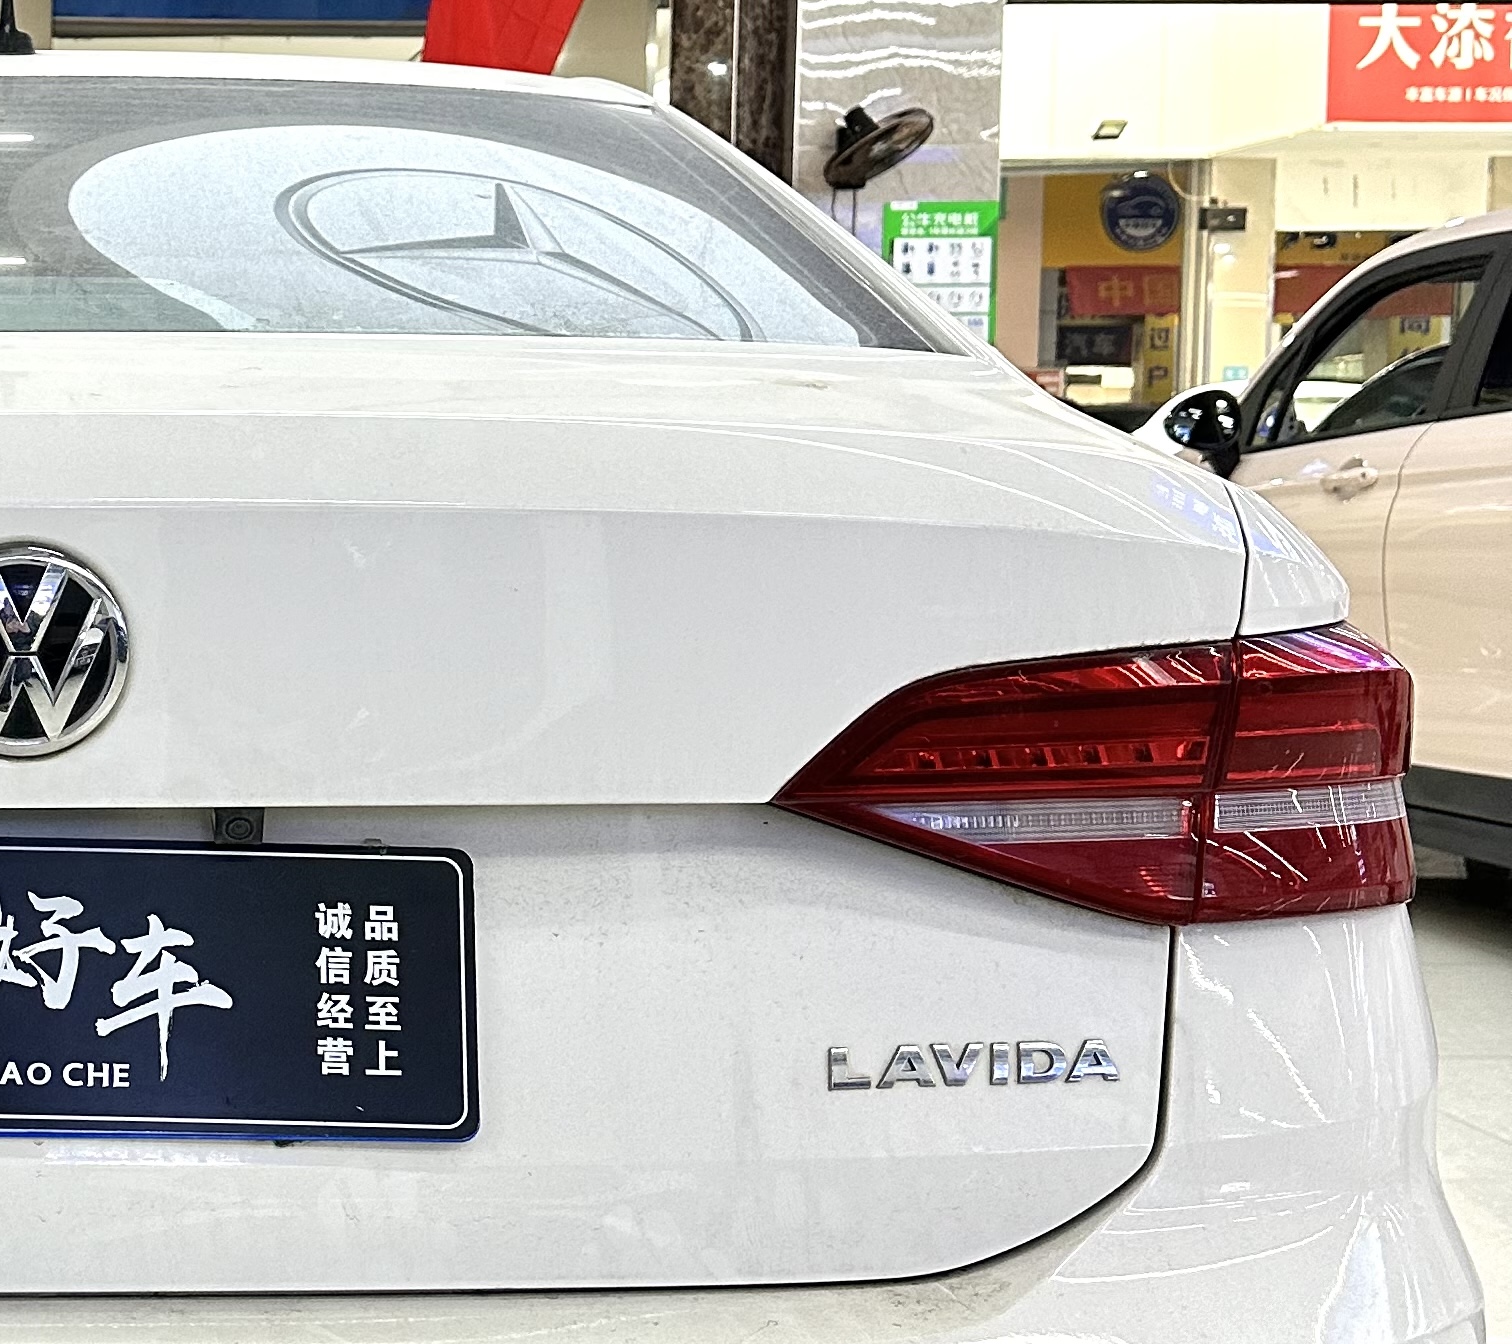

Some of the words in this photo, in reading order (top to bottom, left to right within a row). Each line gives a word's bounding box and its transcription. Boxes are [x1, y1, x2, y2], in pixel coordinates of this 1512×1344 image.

[1355, 3, 1512, 70] 大添
[314, 902, 355, 1077] 诚信经营
[363, 905, 403, 1077] 品质至上
[63, 1061, 131, 1089] CHE
[827, 1038, 1121, 1091] LAVIDA
